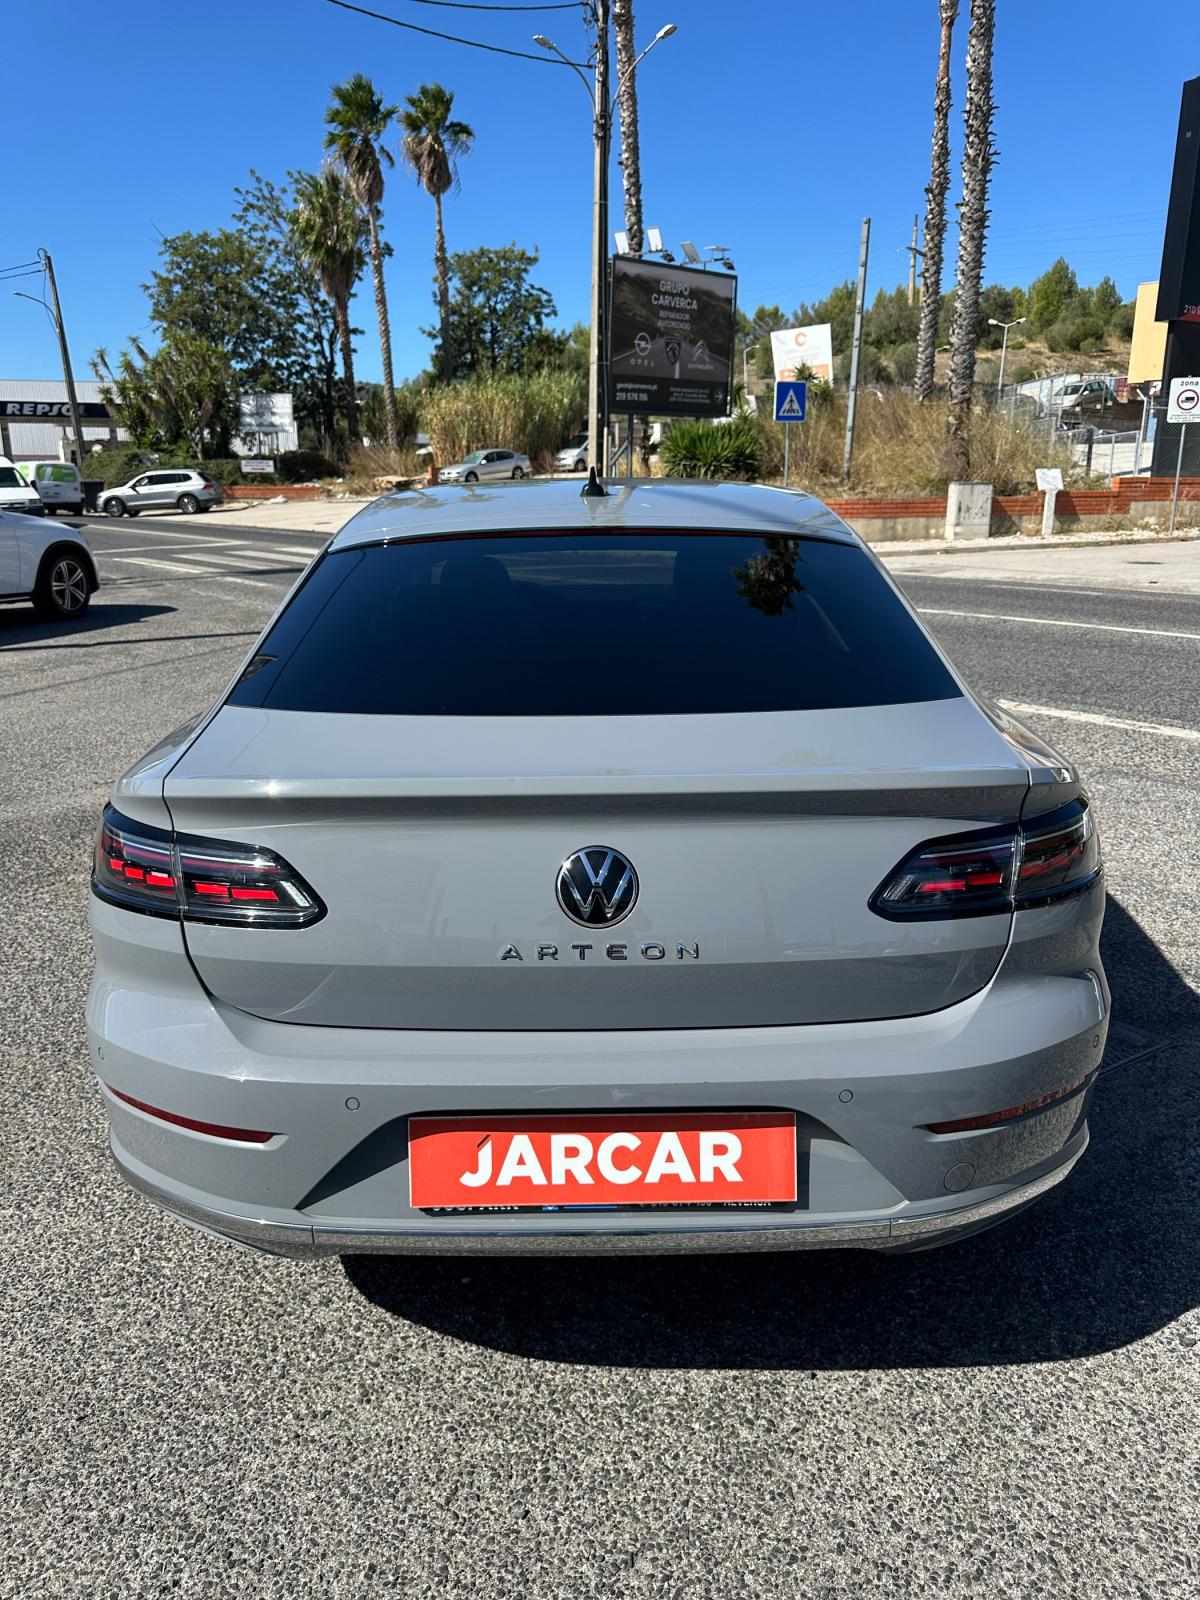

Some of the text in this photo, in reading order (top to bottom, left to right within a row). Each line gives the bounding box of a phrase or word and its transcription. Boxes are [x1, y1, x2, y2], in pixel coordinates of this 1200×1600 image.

[659, 280, 690, 295] GRUPO
[500, 942, 700, 961] ARTEON
[459, 1130, 744, 1188] JARCAR
